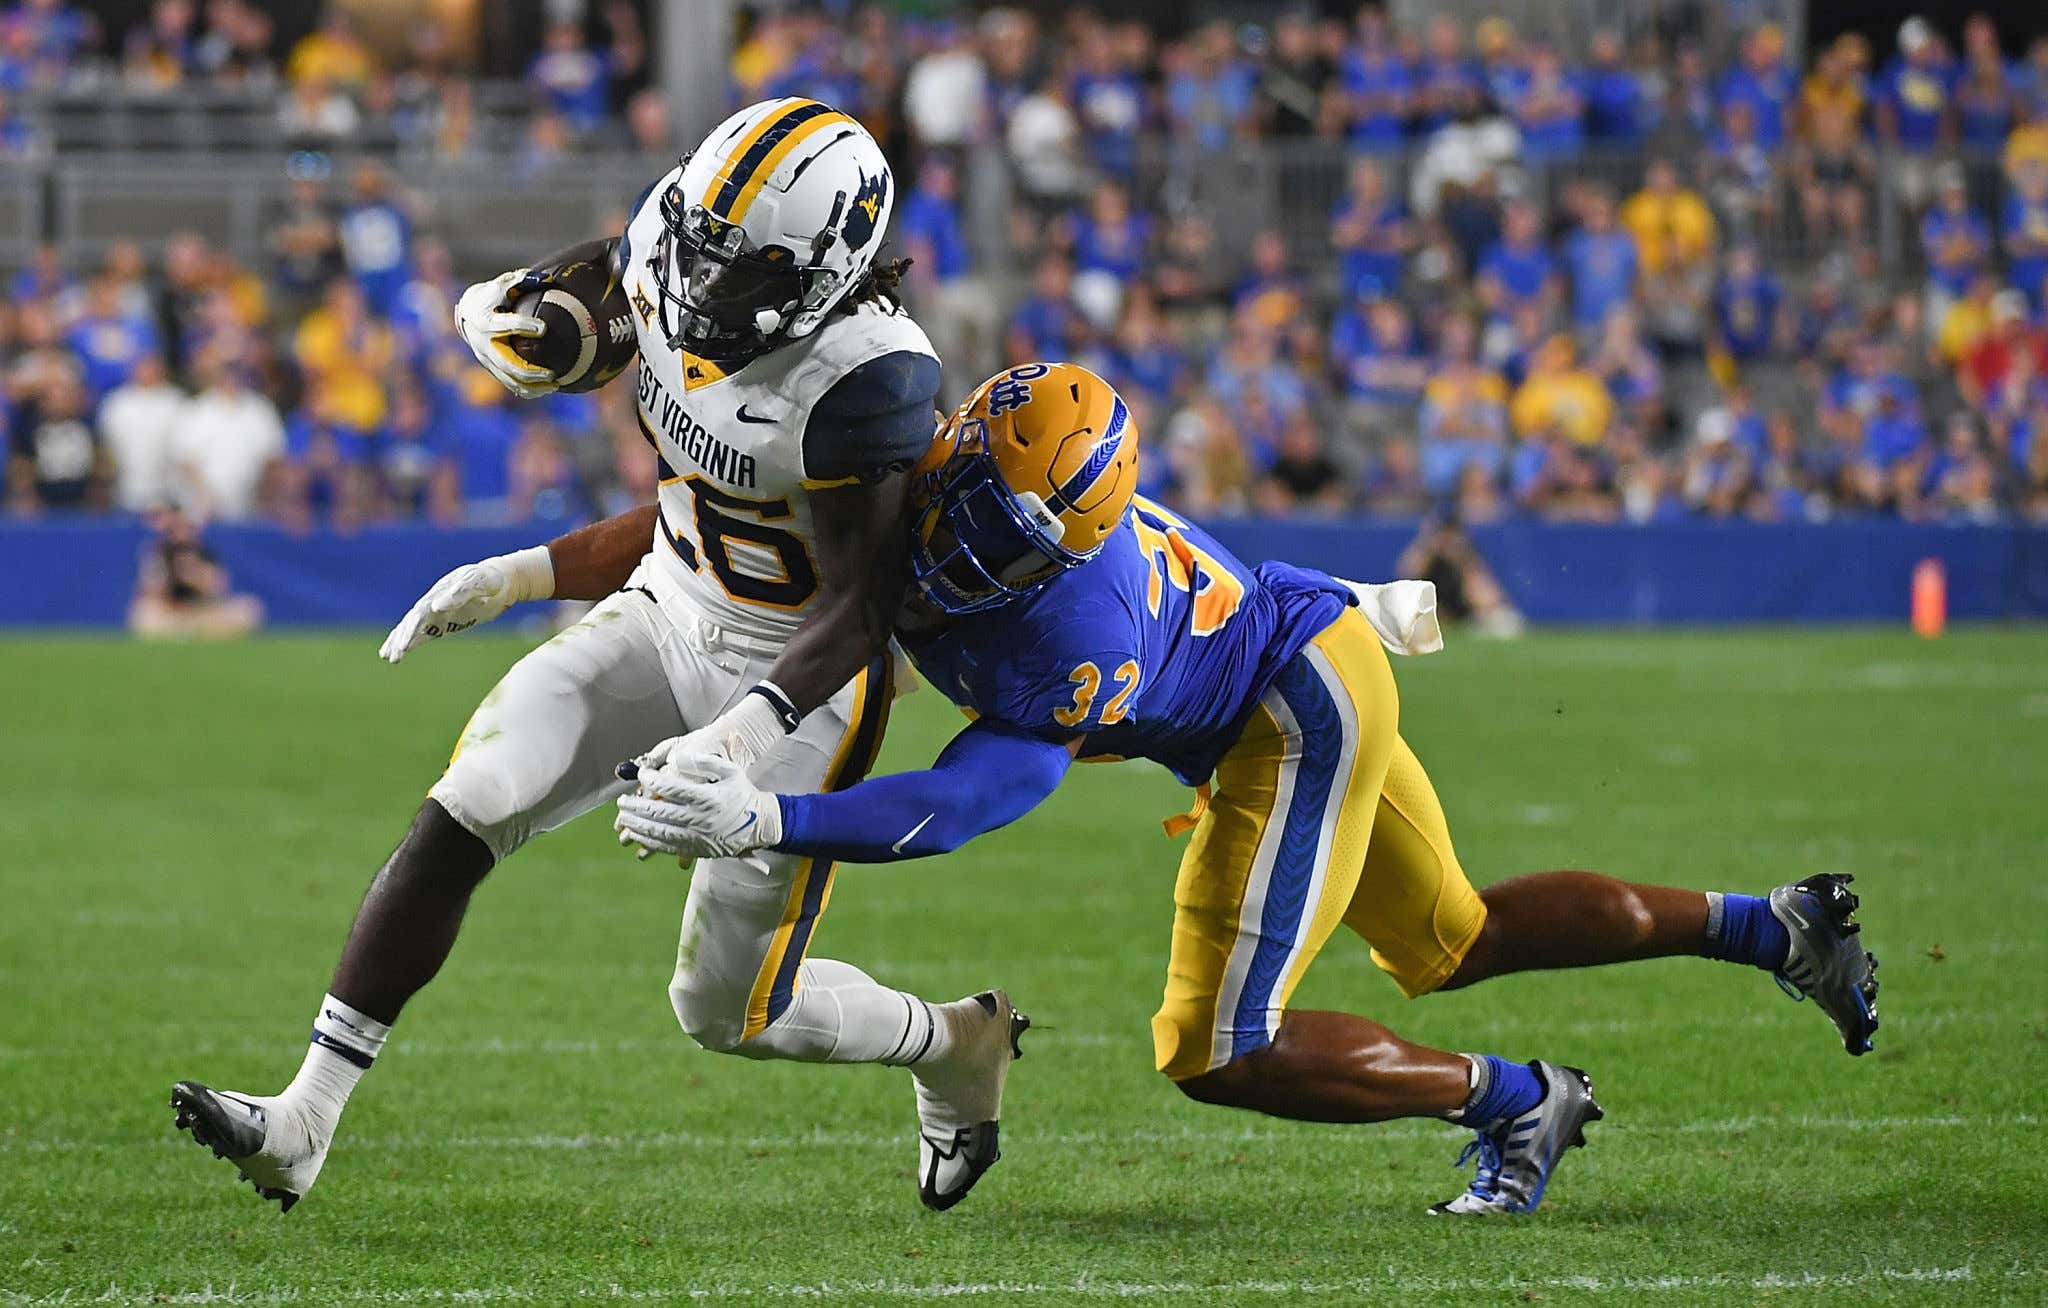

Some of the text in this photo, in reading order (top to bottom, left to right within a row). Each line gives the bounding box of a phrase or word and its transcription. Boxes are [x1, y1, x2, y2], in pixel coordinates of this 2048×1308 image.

[638, 351, 756, 489] EST VIRGINIA
[1053, 658, 1140, 728] 32
